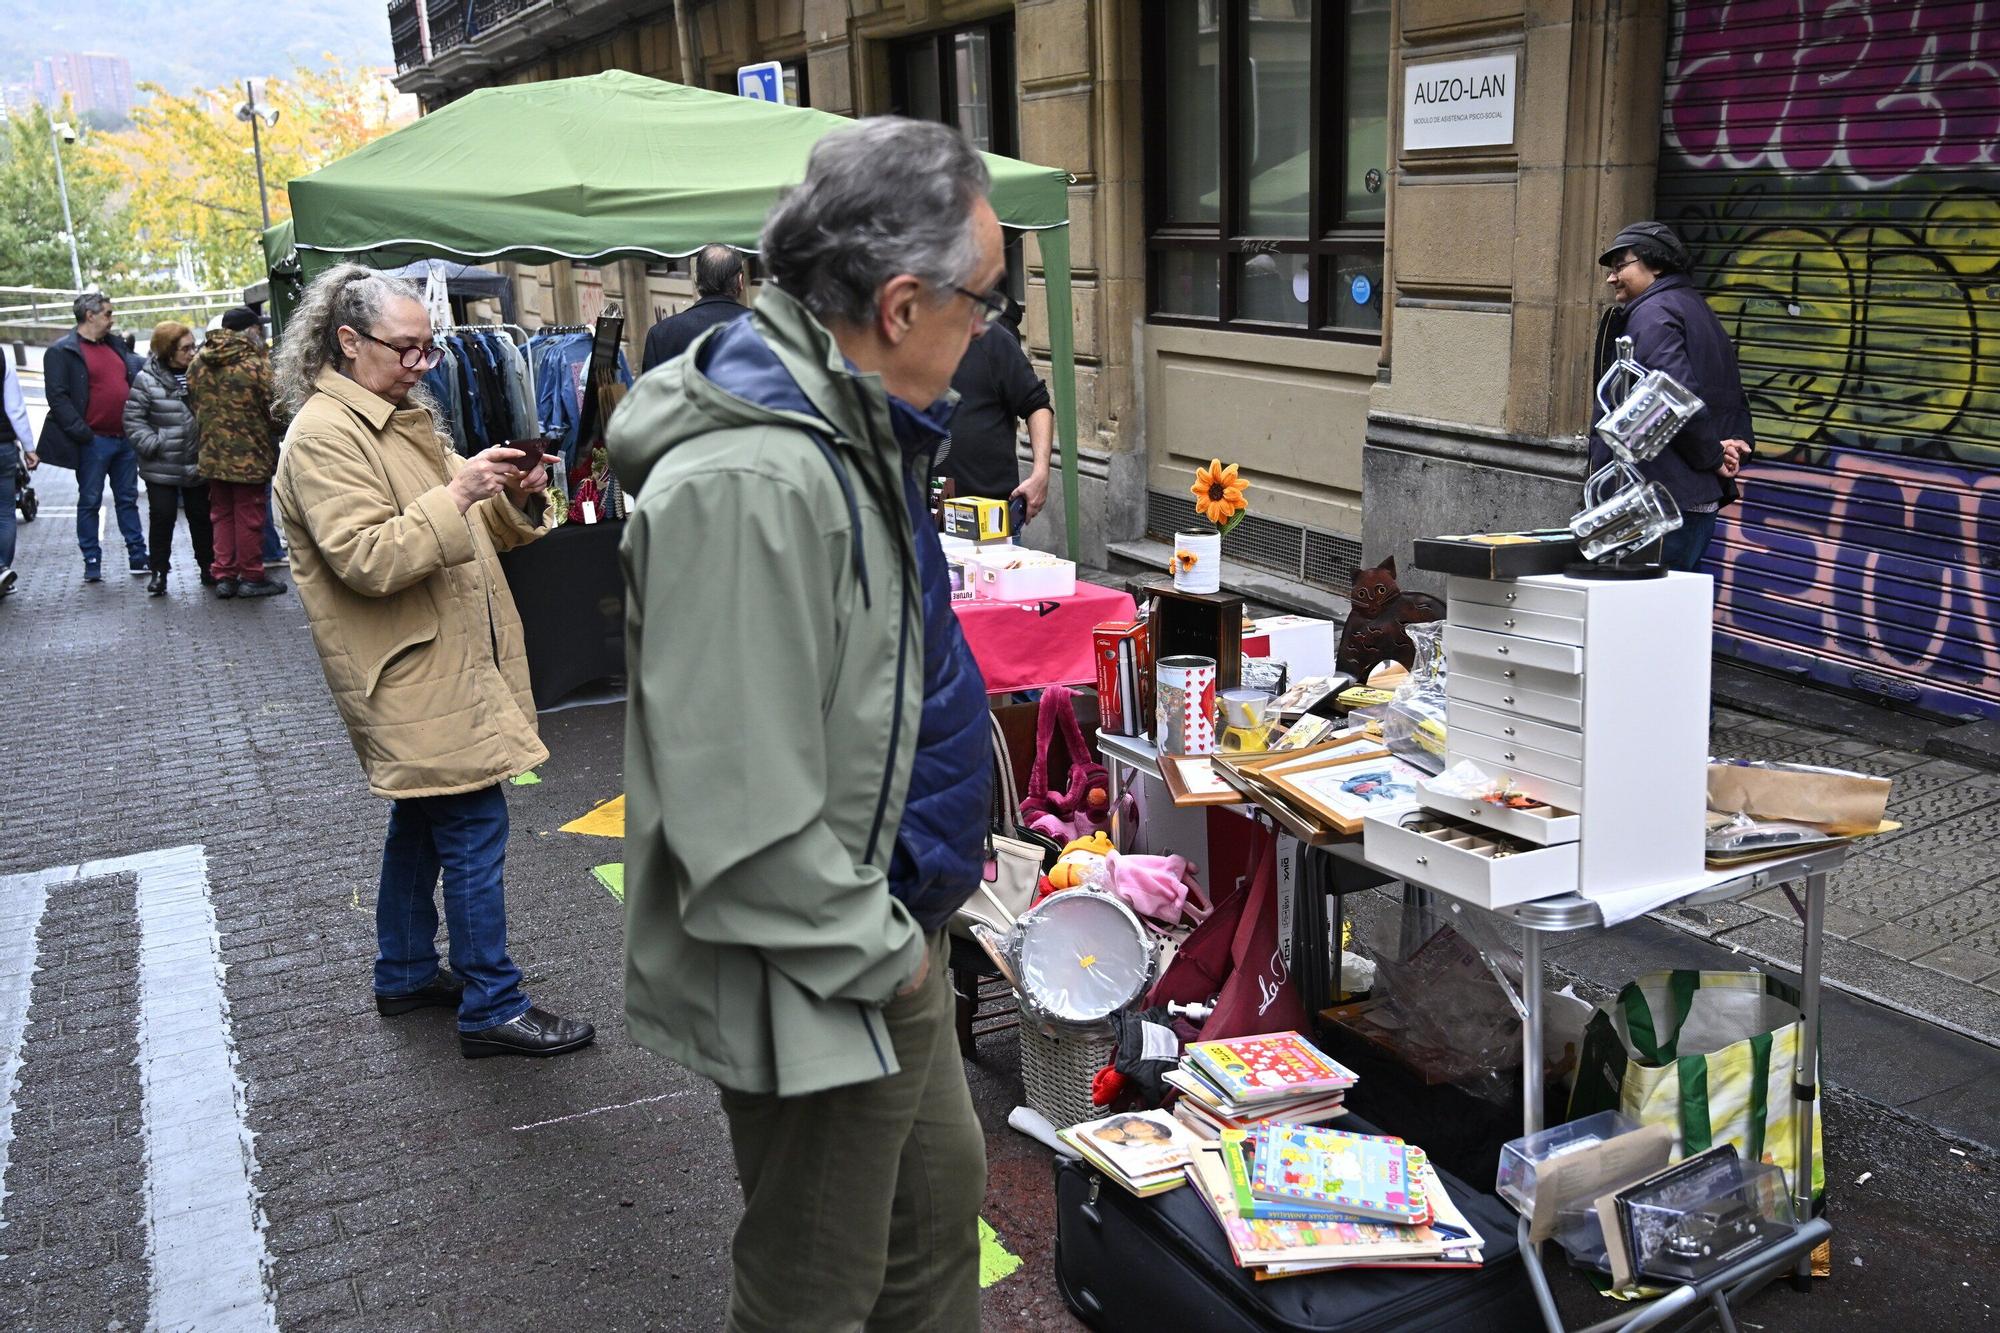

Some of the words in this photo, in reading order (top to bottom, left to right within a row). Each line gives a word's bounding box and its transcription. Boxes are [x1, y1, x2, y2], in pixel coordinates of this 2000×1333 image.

[1413, 73, 1506, 105] AUZO-LAN
[1441, 113, 1468, 123] ASISTENCIA
[1469, 111, 1502, 120] PSICO-SOCIAL
[953, 591, 973, 600] FUTURE
